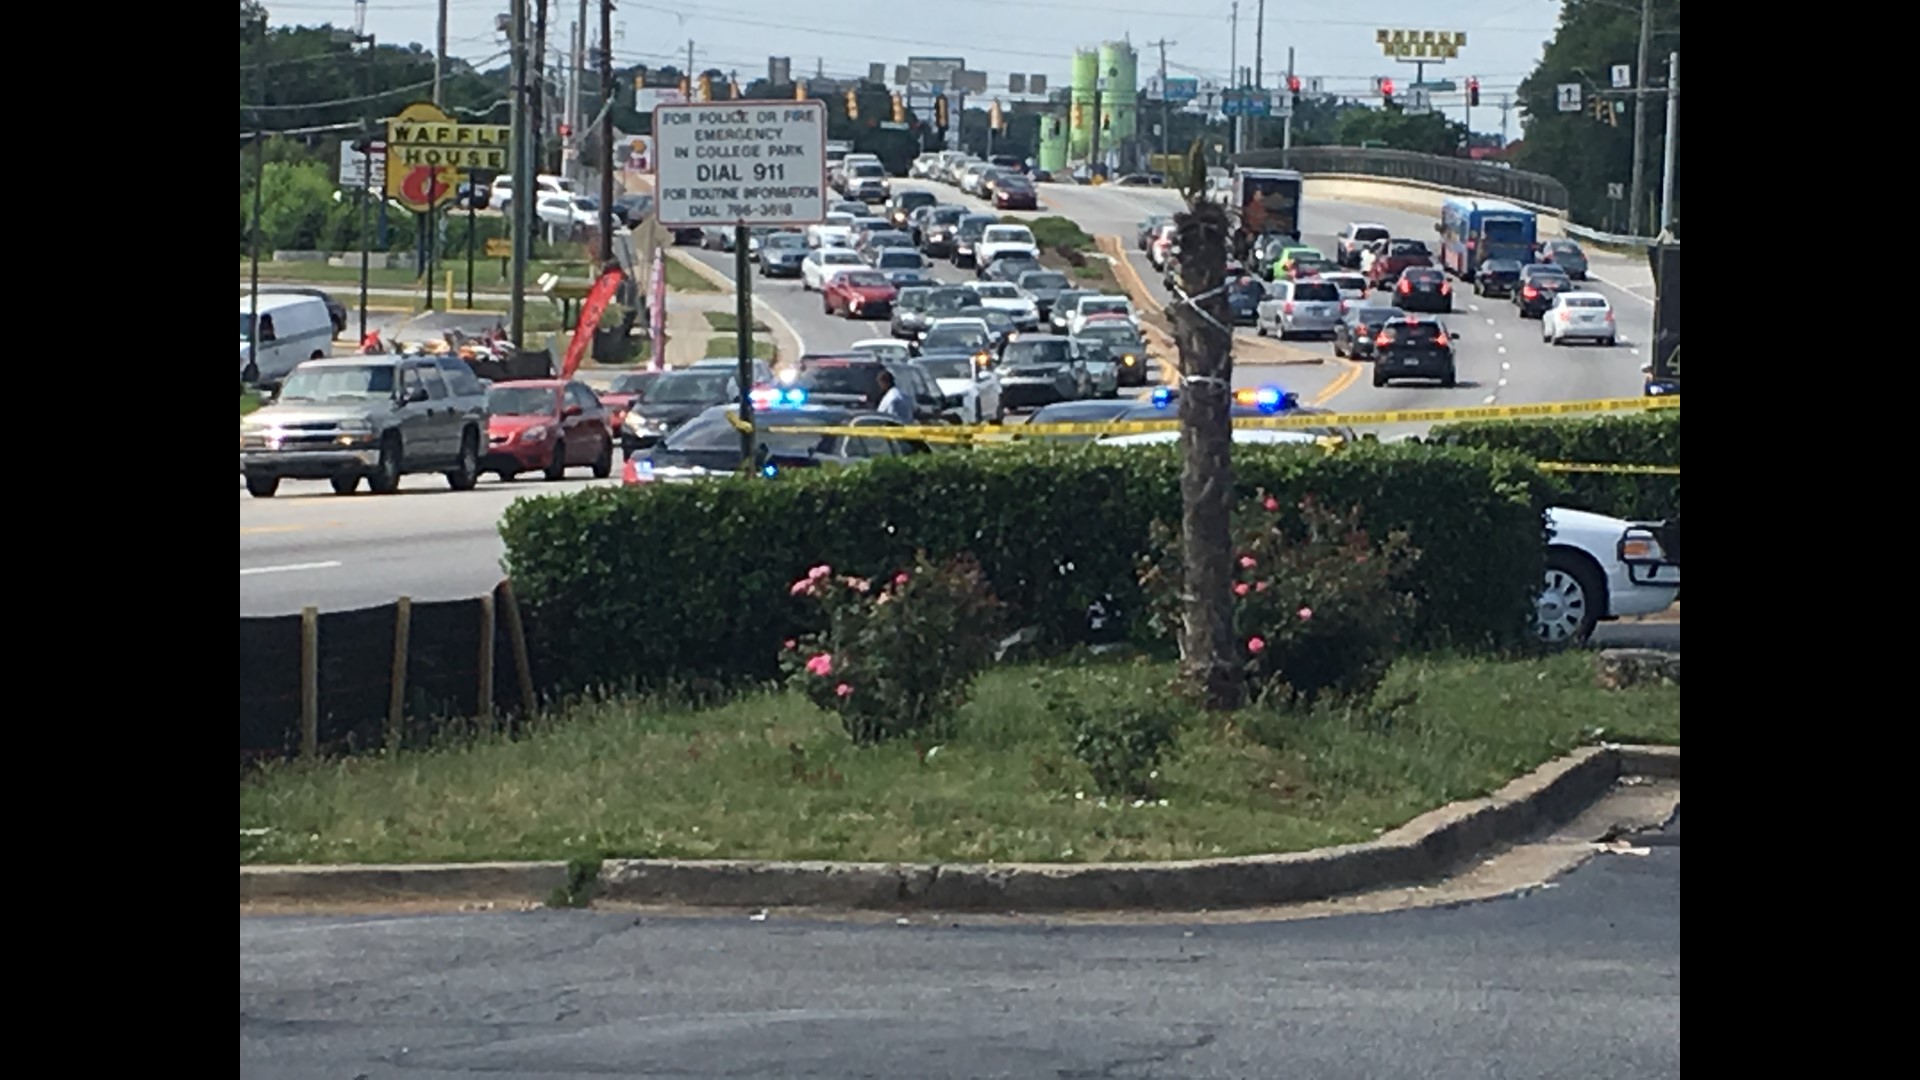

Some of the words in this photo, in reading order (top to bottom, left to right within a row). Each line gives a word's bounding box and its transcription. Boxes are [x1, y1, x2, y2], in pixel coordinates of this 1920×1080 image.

[662, 112, 691, 125] FOR
[699, 110, 749, 124] POLICE
[757, 111, 777, 124] OR
[784, 110, 815, 123] FIRE
[394, 127, 510, 143] WAFFLE
[695, 127, 783, 141] EMERGENCY
[405, 148, 501, 167] HOUSE
[674, 147, 688, 158] IN
[696, 145, 760, 159] COLLEGE
[769, 145, 804, 157] PARK
[697, 164, 743, 182] DIAL
[753, 163, 784, 181] 911
[663, 188, 686, 200] FOR
[691, 187, 739, 200] ROUTINE
[744, 186, 819, 199] INFORMATION
[689, 205, 720, 217] DIAL
